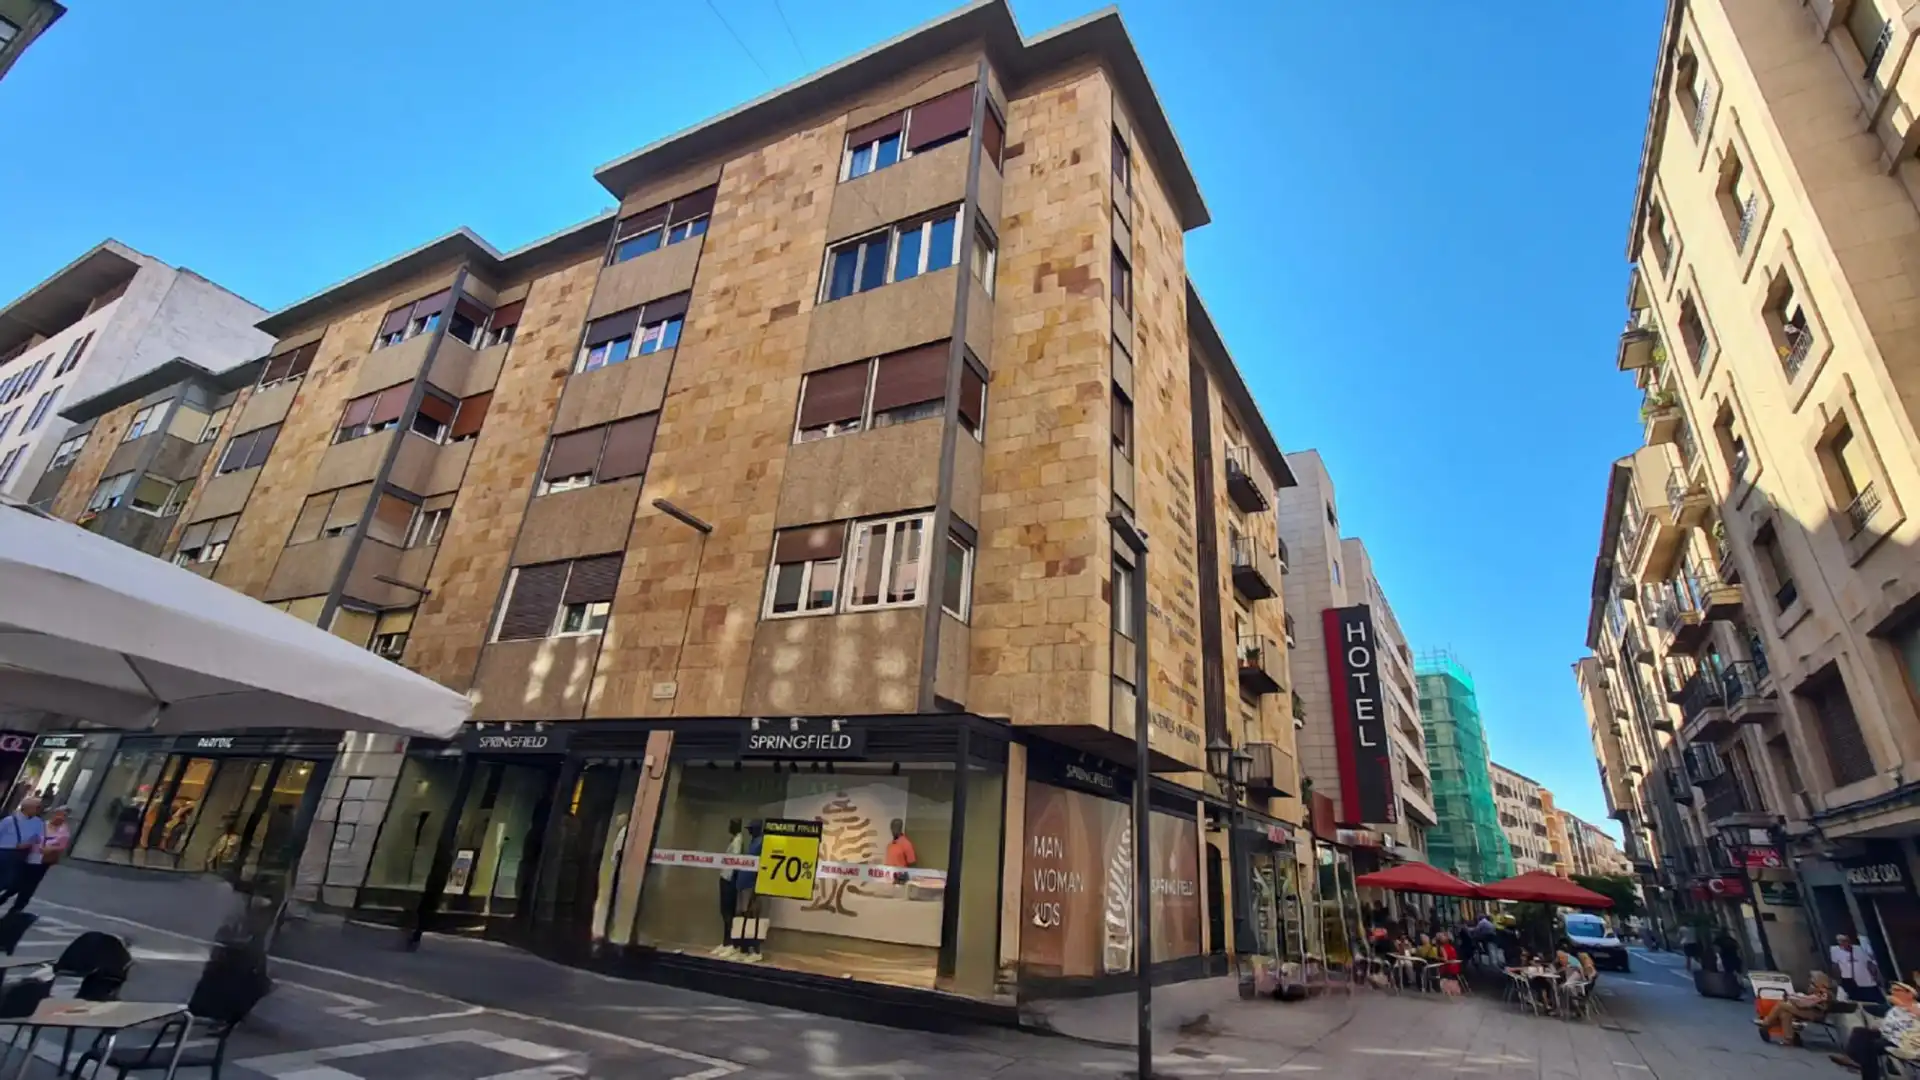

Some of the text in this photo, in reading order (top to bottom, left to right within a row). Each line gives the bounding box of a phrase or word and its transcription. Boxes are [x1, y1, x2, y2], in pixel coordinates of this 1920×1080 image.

[1346, 621, 1377, 747] HOTEL
[479, 735, 548, 749] SPRINGFIELD
[748, 734, 852, 750] SPRINGFIELD
[1033, 835, 1063, 859] MAN
[1033, 868, 1085, 893] WOMAN
